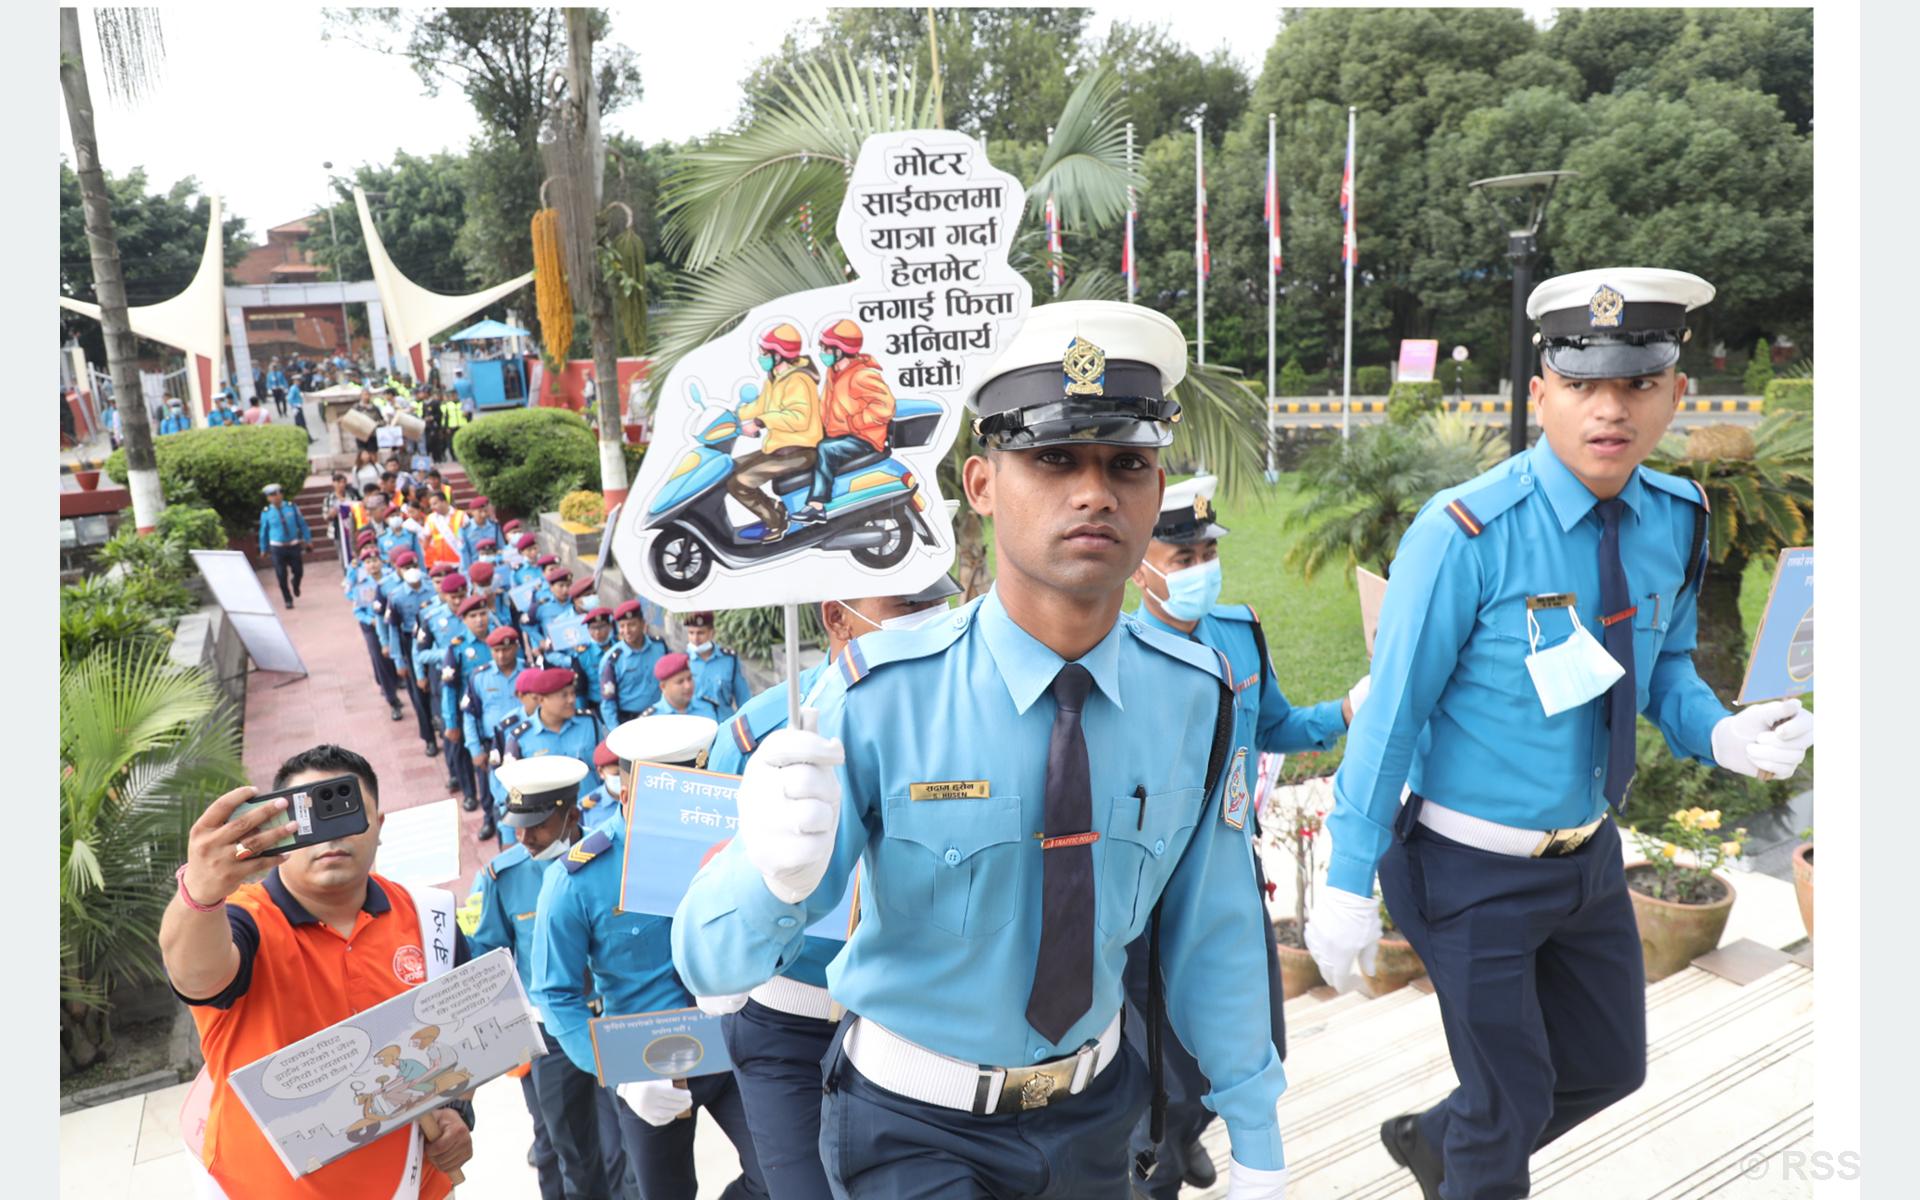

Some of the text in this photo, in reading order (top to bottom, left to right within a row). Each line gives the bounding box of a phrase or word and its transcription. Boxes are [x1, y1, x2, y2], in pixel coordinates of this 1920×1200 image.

[893, 147, 967, 176] मोटर
[861, 185, 1003, 216] साईकलमा
[870, 216, 998, 250] यात्रा गर्दा
[890, 253, 981, 287] हेलमेट
[858, 287, 1014, 322] लगाई फित्ता
[885, 322, 992, 355] अनिवार्य
[644, 772, 677, 792] अति
[680, 806, 740, 831] हर्नको प्र
